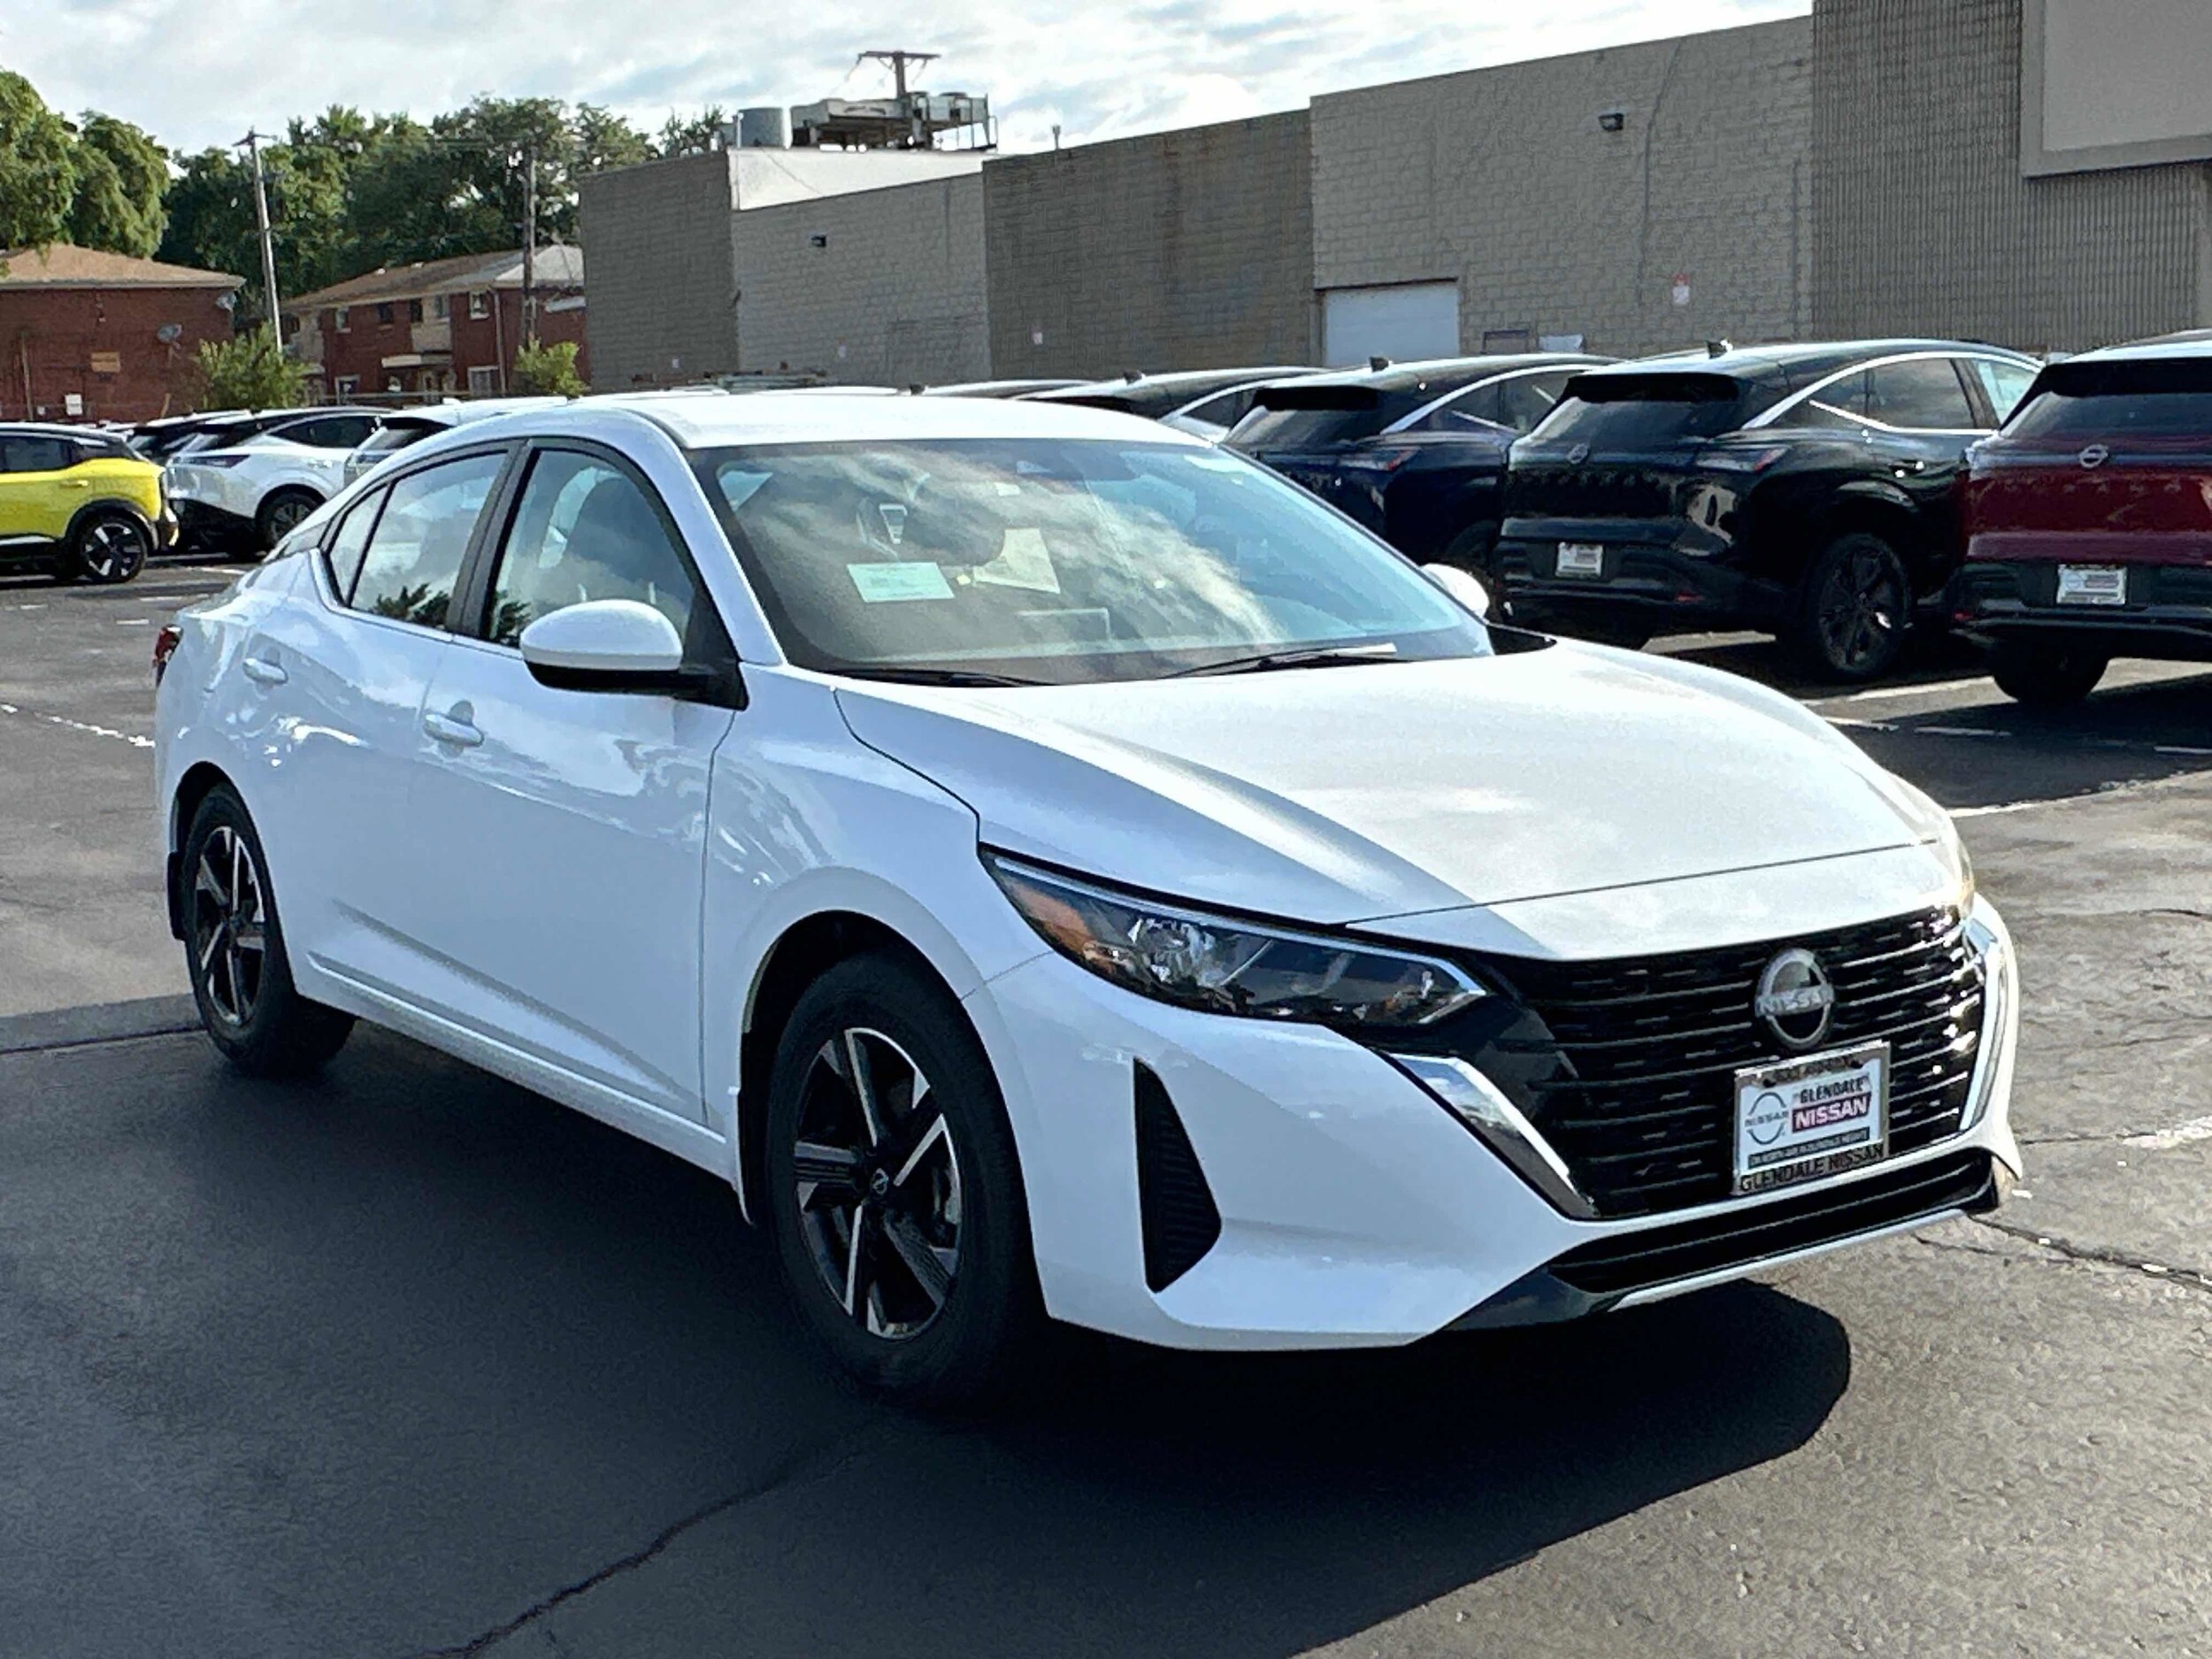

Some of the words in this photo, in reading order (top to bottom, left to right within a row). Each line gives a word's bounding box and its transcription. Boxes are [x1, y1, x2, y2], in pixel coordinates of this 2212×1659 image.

[1800, 1076, 1865, 1103] GLENDALE
[1795, 1095, 1868, 1129] NISSAN
[1740, 1158, 1824, 1191] GLENDALE
[1828, 1142, 1884, 1171] NISSAN
